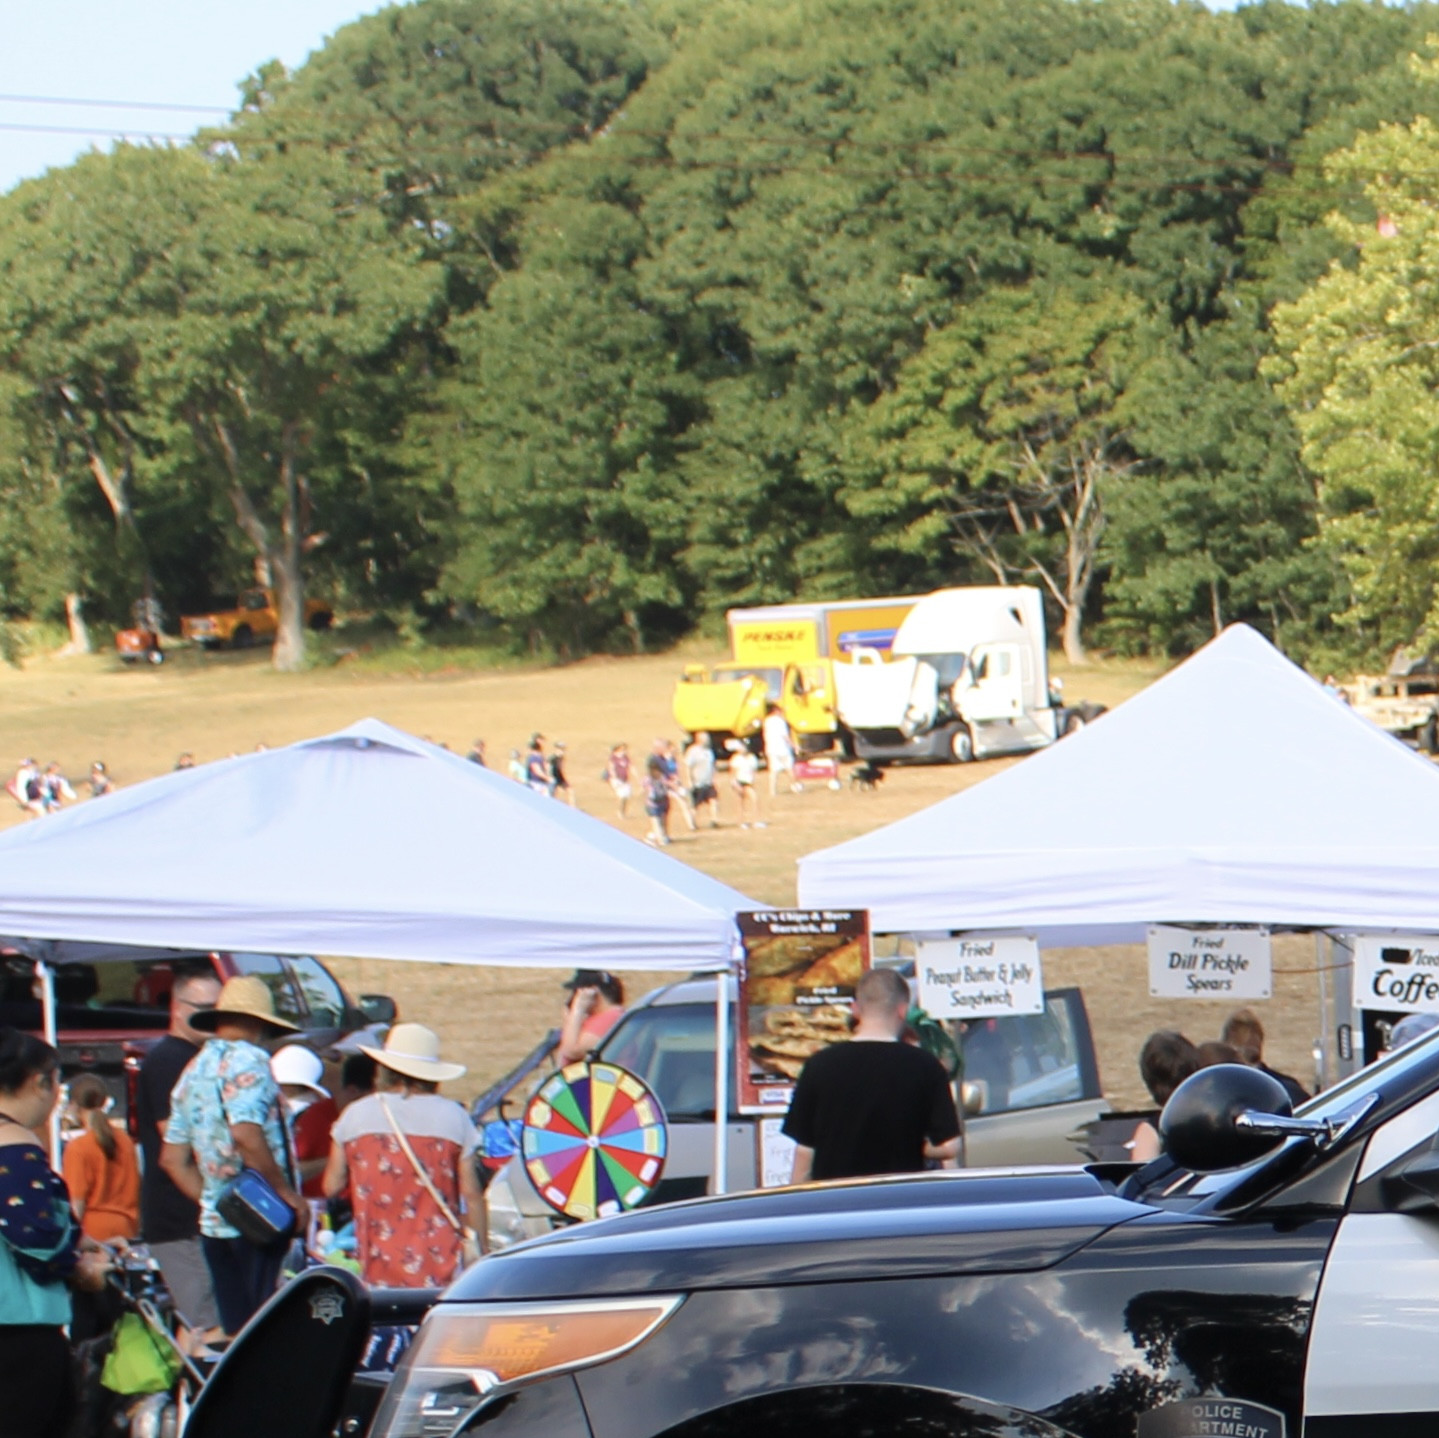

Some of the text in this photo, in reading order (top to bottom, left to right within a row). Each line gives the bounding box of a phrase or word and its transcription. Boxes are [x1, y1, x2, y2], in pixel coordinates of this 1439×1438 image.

[742, 629, 806, 643] PENSKE
[960, 941, 995, 957] Fried
[1192, 936, 1225, 949] Fried
[1168, 951, 1250, 975] Dill Pickle
[926, 962, 1033, 988] Peanut Butter & Jelly
[1186, 973, 1232, 994] Spears
[950, 989, 1013, 1010] Sandwich
